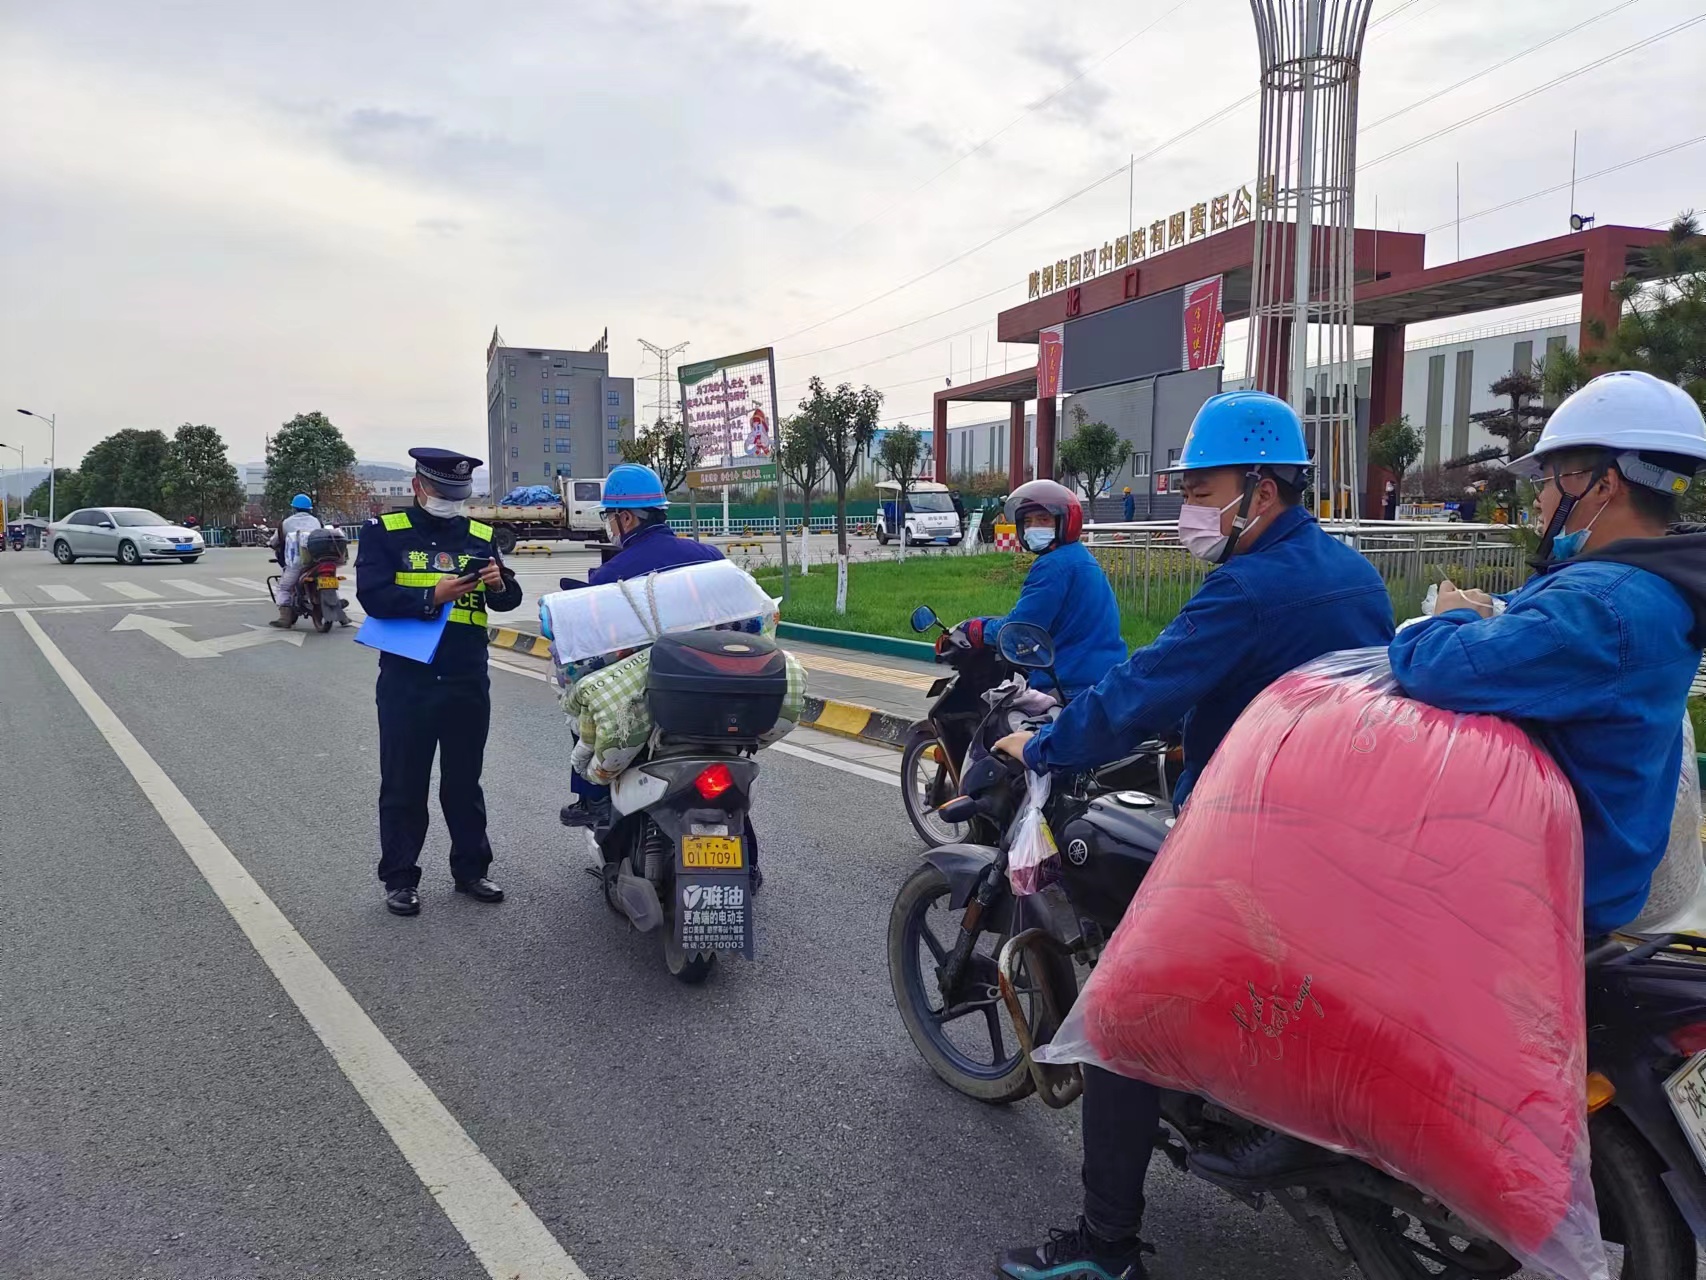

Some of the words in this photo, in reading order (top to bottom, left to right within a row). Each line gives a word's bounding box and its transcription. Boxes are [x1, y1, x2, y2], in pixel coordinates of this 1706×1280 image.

[408, 550, 430, 570] 警
[610, 652, 648, 679] xiong
[687, 851, 737, 865] 0117091
[701, 885, 744, 909] 雅迪
[683, 910, 744, 925] 更高端的电动车
